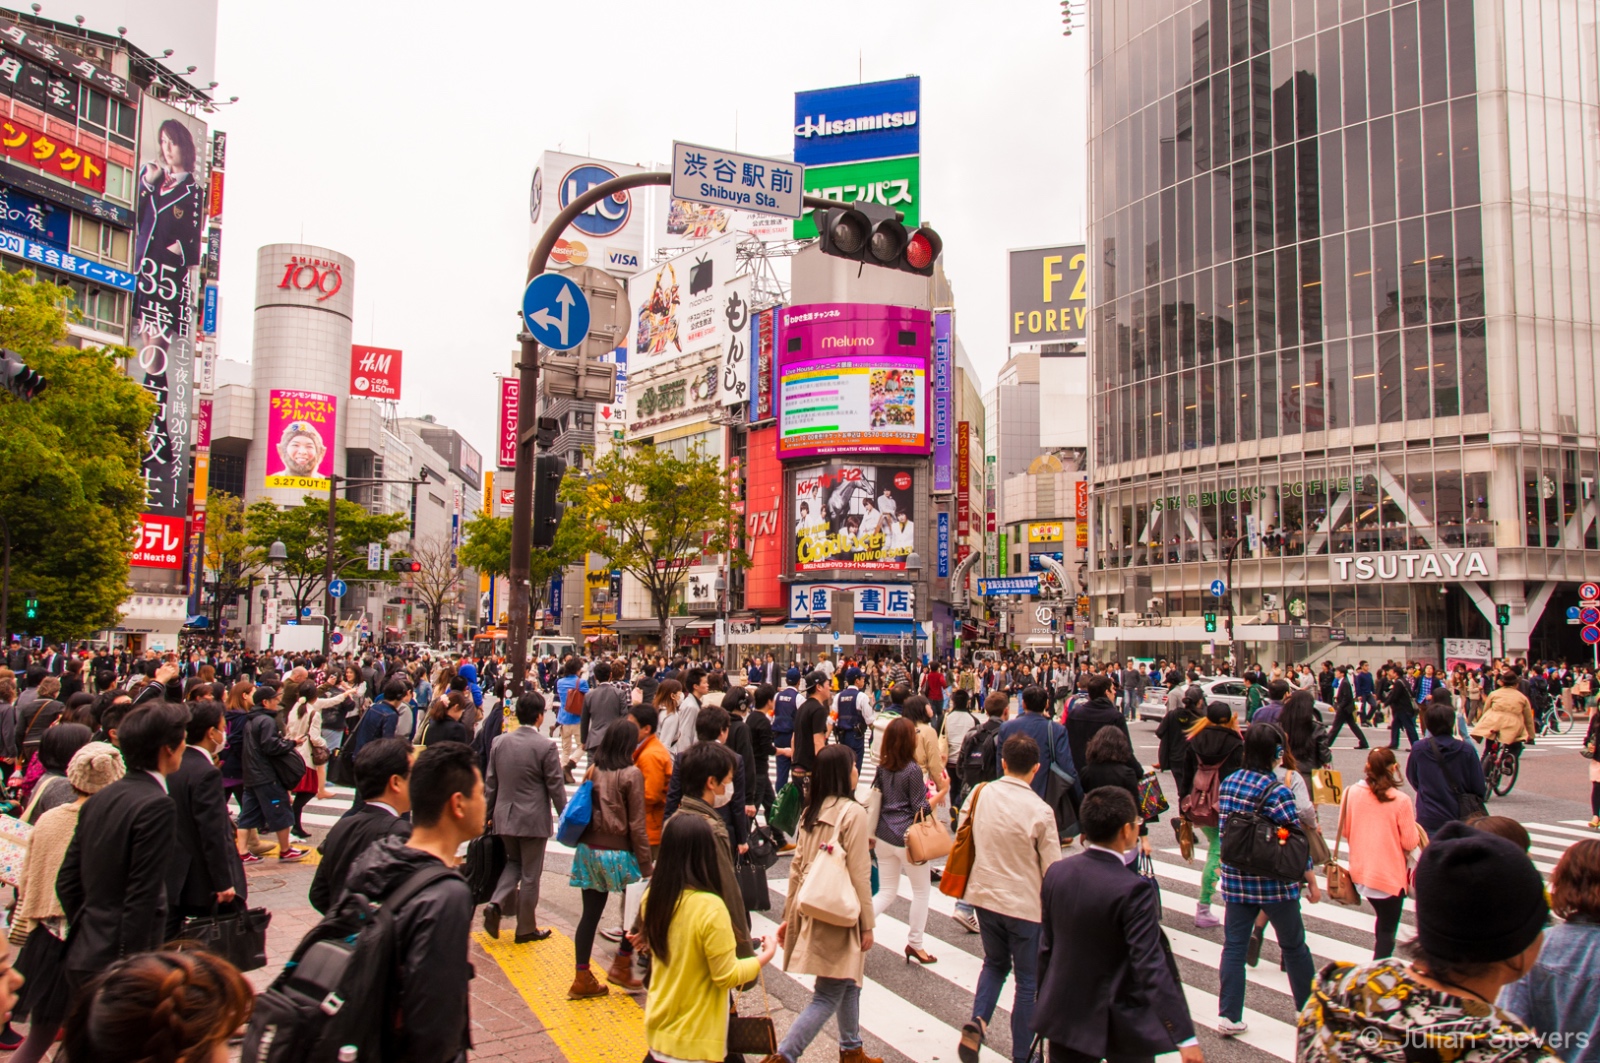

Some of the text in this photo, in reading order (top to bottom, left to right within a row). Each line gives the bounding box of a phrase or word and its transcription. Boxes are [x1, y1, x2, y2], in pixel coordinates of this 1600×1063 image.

[3, 123, 101, 179] ンタクト
[684, 152, 793, 194] 渋谷駅前
[701, 184, 780, 208] Shibuya Sta.
[28, 243, 132, 286] 英会話イーオン
[291, 256, 341, 271] SHIBUYA
[609, 252, 638, 267] VISA
[277, 262, 343, 301] 109
[1014, 306, 1087, 335] FOREV
[724, 291, 748, 399] もんじゃ
[358, 352, 392, 375] H&M
[370, 384, 395, 395] 150m
[271, 397, 335, 414] ラストベスト
[281, 408, 327, 424] アルバム
[501, 379, 519, 465] Essential
[959, 424, 968, 488] クスリのことなら
[273, 478, 295, 487] 3.27
[1155, 475, 1364, 512] STARBUCKS COFFEE
[749, 495, 780, 561] クスリ
[144, 552, 165, 562] Next
[853, 550, 874, 563] NOW
[939, 516, 948, 574] 大盛堂商事ビル
[1334, 551, 1489, 581] TSUTAYA
[795, 588, 909, 613] 大盛書店
